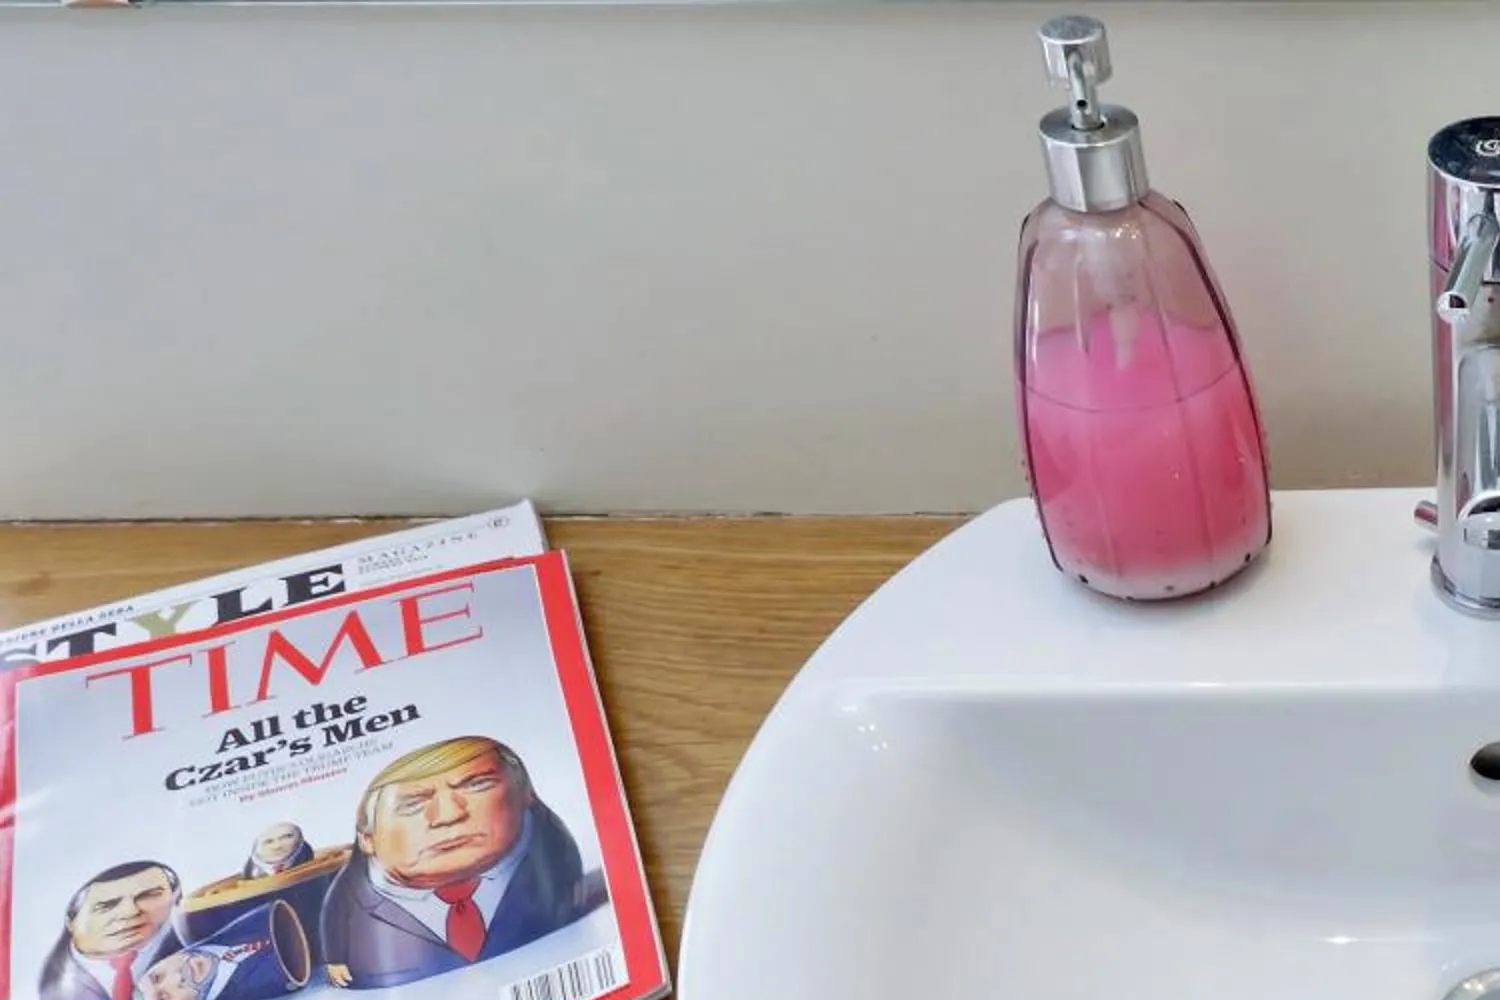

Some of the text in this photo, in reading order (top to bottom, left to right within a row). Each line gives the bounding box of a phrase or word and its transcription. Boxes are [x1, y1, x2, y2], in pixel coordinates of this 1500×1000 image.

[86, 580, 483, 740] TIME
[164, 702, 422, 791] Czar's Men
[215, 695, 368, 754] All the
